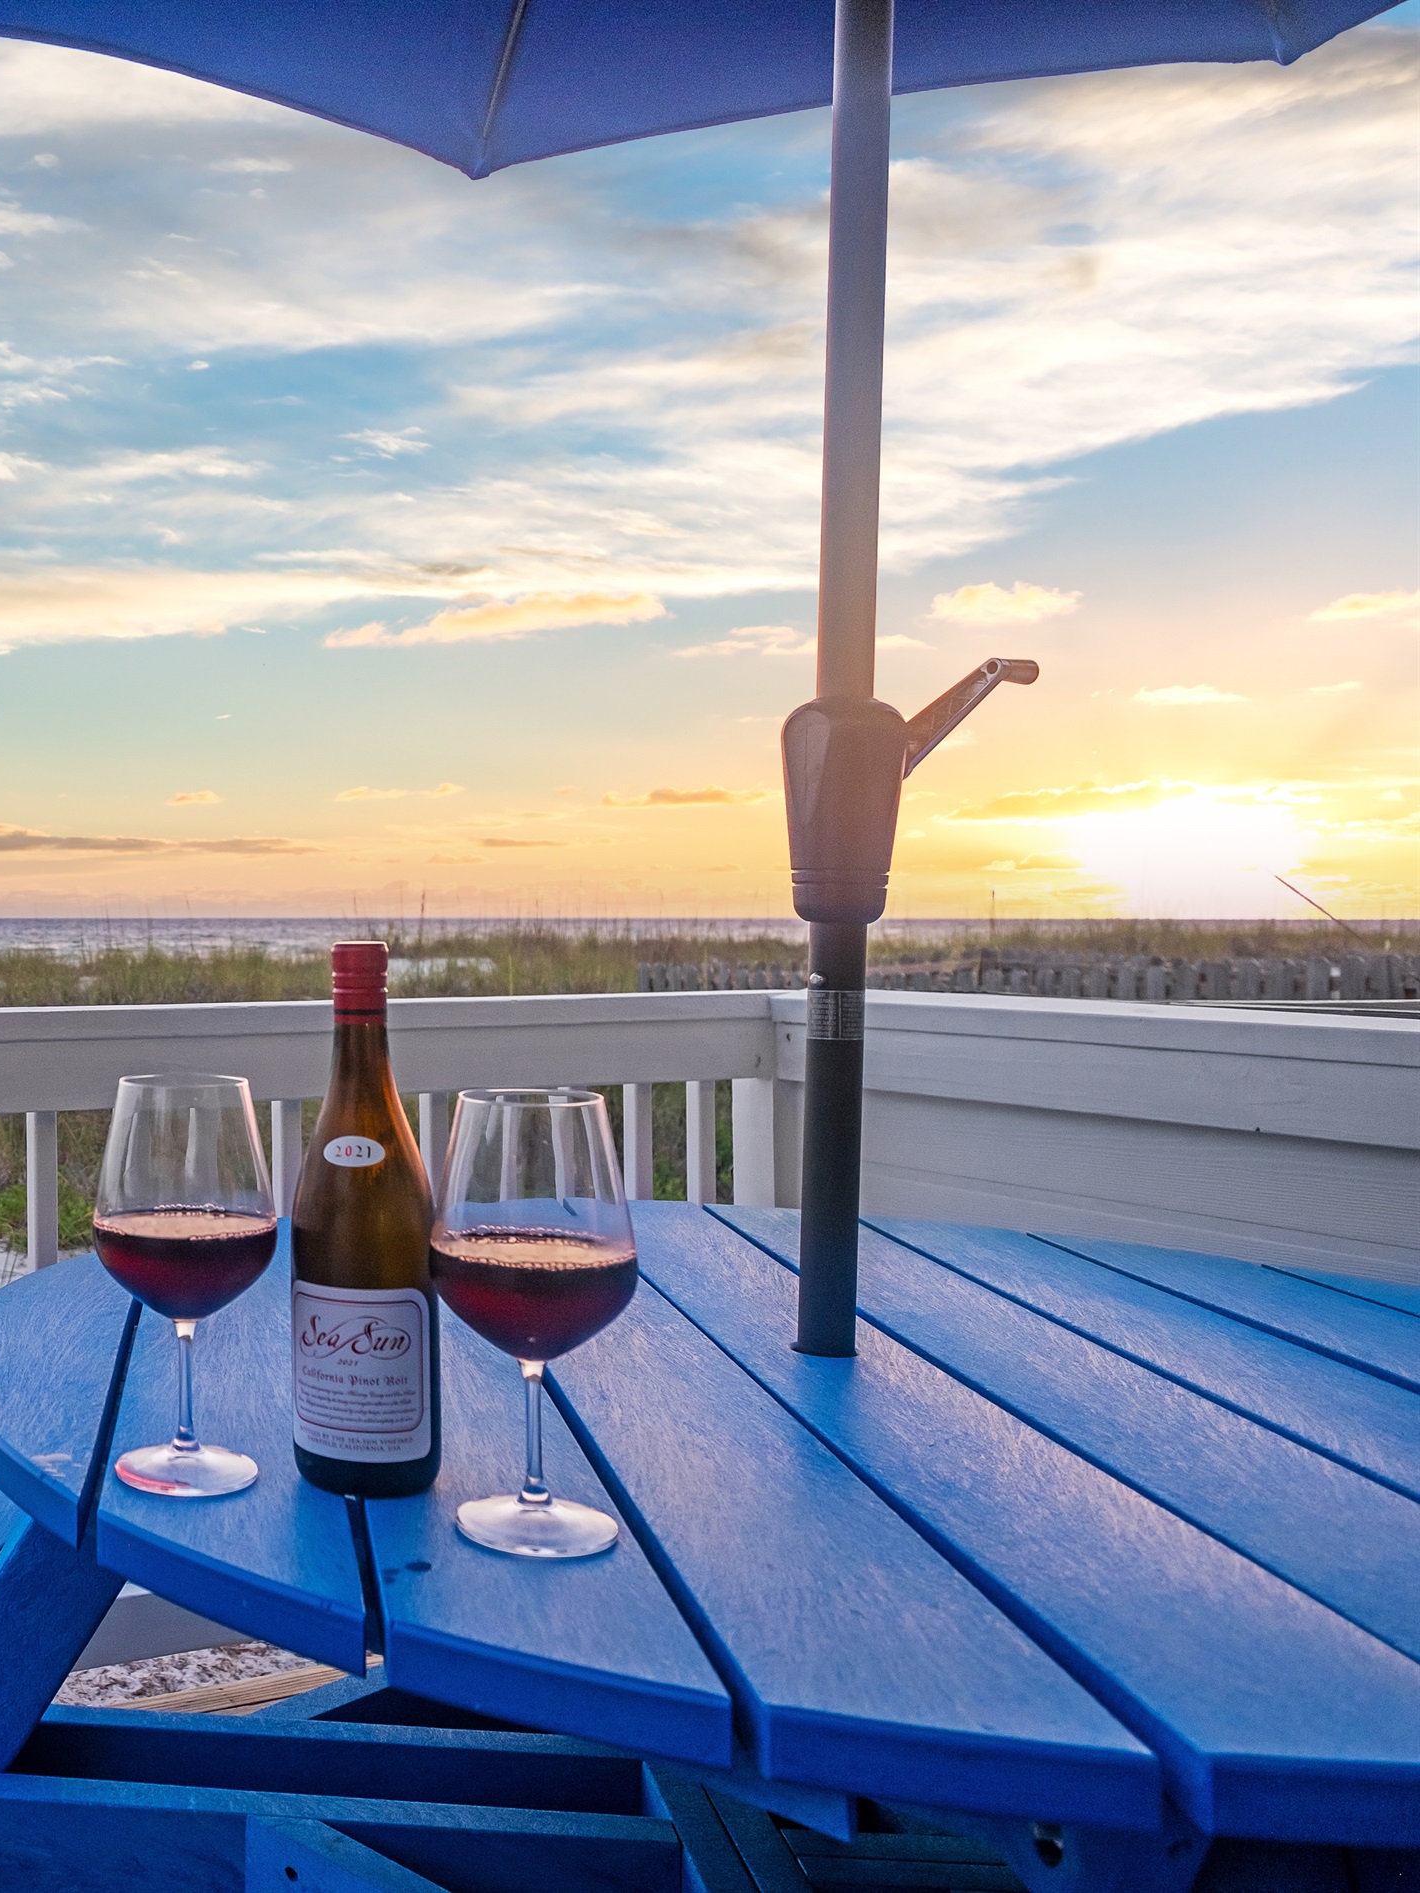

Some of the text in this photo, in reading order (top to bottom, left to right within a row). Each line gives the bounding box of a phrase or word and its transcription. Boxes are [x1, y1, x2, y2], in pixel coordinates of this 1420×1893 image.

[335, 1144, 372, 1159] 2021
[301, 1314, 406, 1355] Sea Sun
[336, 1358, 359, 1368] 2021
[301, 1364, 409, 1387] California Pinot Noir
